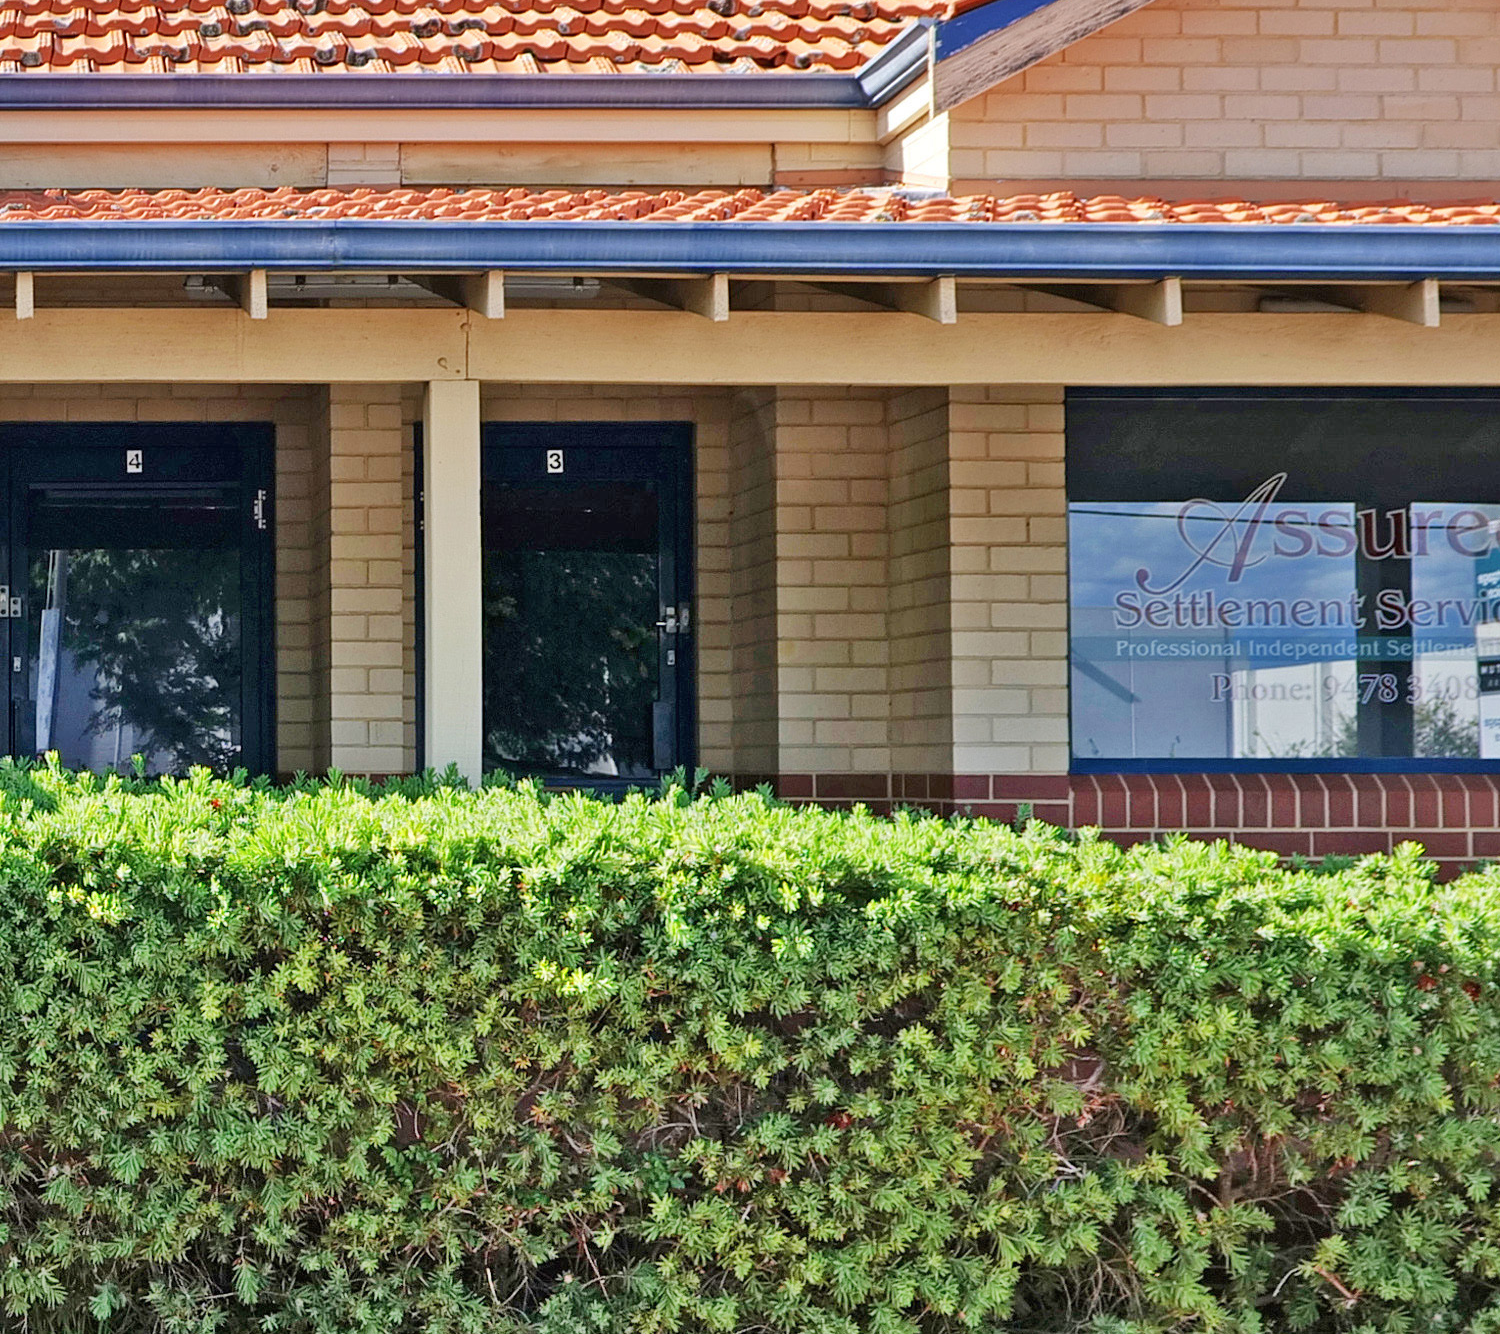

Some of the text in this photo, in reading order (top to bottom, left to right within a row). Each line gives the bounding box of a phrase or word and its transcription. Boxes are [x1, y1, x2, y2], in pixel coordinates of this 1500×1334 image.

[128, 453, 142, 469] 4
[549, 452, 562, 470] 3
[1113, 589, 1366, 630] Settlement
[1115, 639, 1241, 657] Professional
[1249, 639, 1379, 659] Independent
[1210, 672, 1481, 704] Phone: 9478 3408
